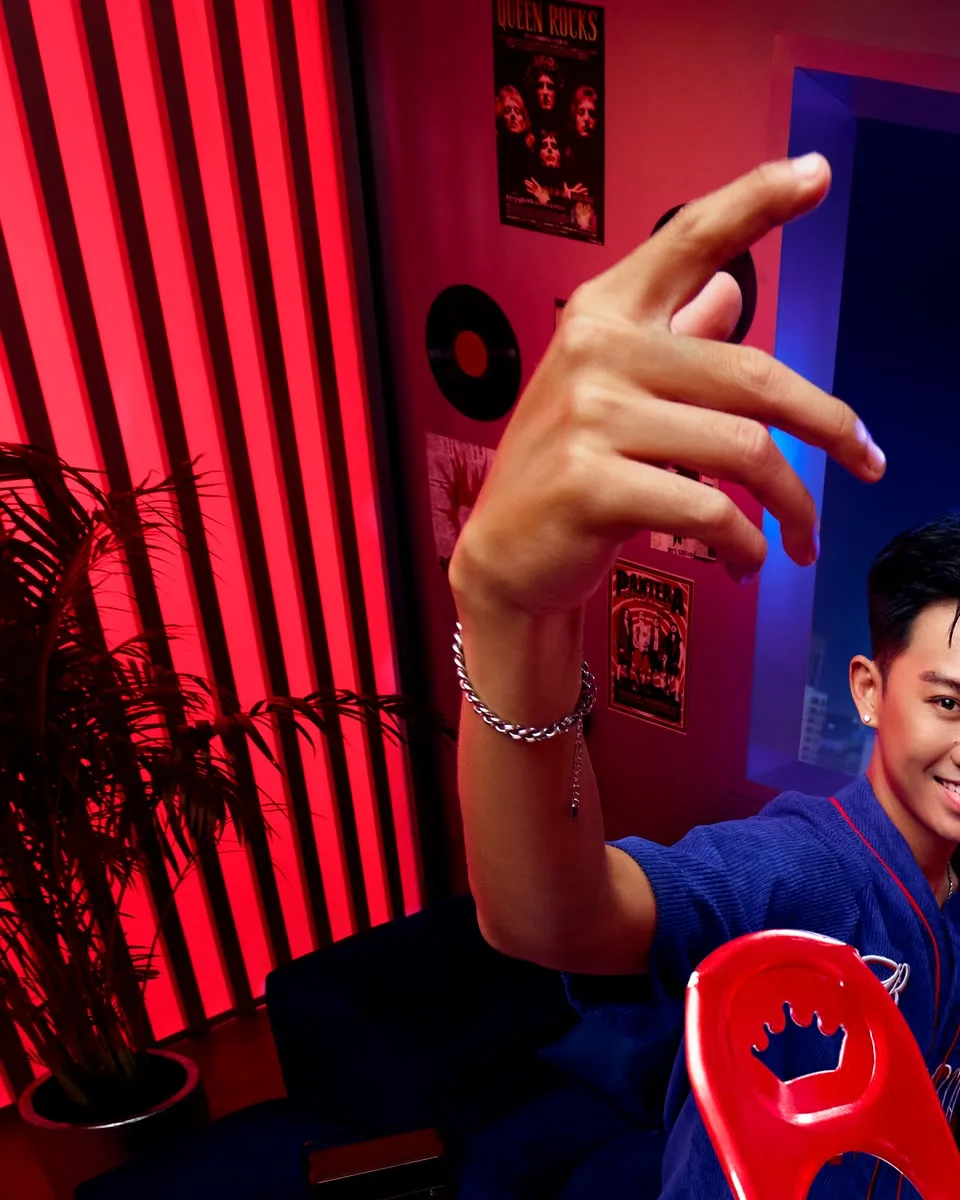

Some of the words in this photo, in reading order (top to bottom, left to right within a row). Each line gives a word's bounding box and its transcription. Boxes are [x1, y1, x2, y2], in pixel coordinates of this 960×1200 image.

[497, 0, 543, 33] QUEEN
[548, 4, 598, 41] ROCKS
[615, 568, 685, 617] PANTERA
